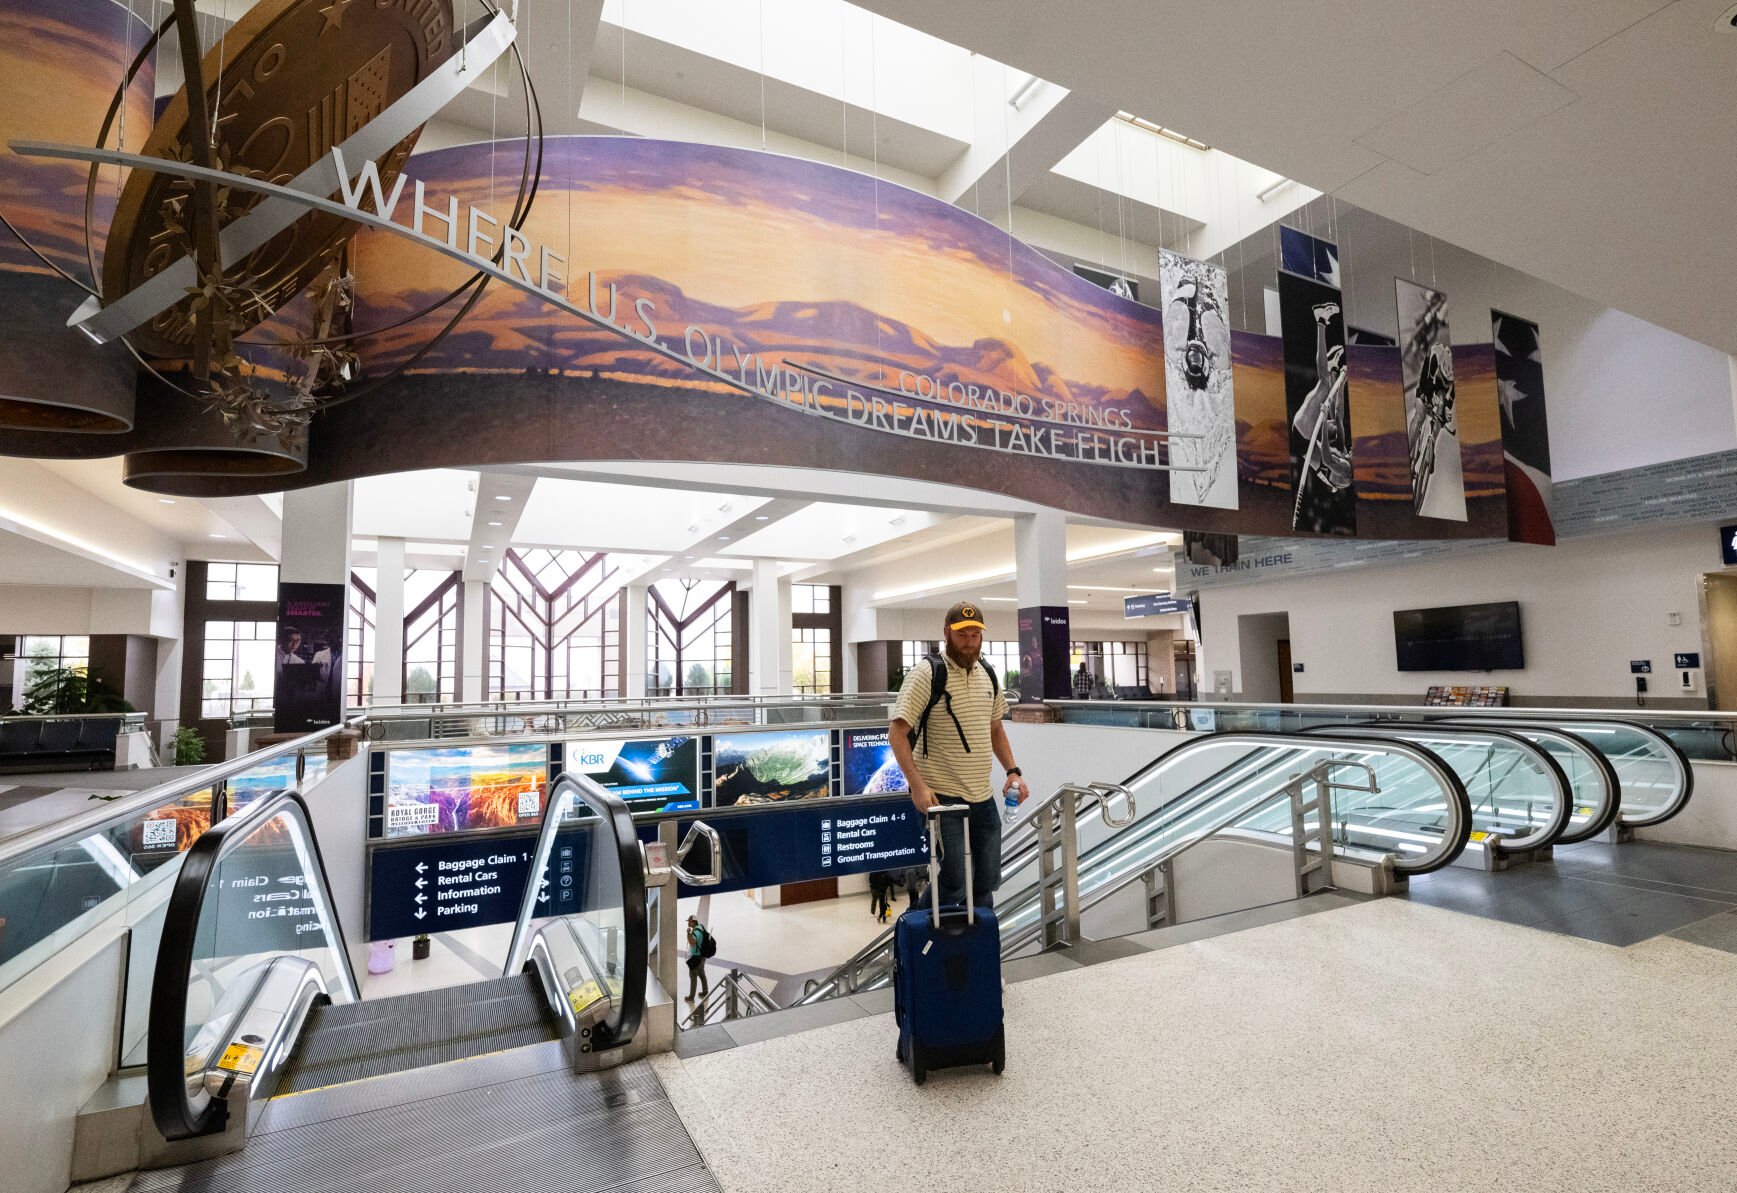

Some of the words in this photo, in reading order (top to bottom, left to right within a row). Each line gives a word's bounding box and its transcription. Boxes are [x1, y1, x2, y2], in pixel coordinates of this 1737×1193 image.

[331, 146, 570, 302] WHERE
[588, 271, 668, 351] U.S.
[684, 325, 834, 417] OLYMPIC
[847, 389, 978, 446] DREAMS
[986, 418, 1067, 459] TAKE
[1077, 431, 1180, 468] FLIGHT
[899, 371, 1034, 418] COLORADO
[1041, 399, 1132, 430] SPRINGS
[1191, 566, 1210, 577] WE
[1254, 553, 1293, 568] HERE
[580, 753, 605, 766] KBR
[622, 788, 643, 796] BEHIND
[390, 815, 413, 823] BRIDGE
[391, 808, 412, 817] ROYAL
[414, 806, 437, 815] GORGE
[836, 817, 868, 828] Baggage
[868, 814, 889, 824] Claim
[891, 813, 896, 822] 4
[901, 812, 906, 821] 6
[837, 829, 860, 840] Rental
[861, 828, 877, 837] Cars
[837, 840, 875, 852] Restrooms
[438, 858, 486, 872] Baggage
[487, 854, 517, 866] Claim
[522, 852, 528, 861] 1
[837, 852, 865, 864] Ground
[865, 847, 916, 860] Transportation
[438, 872, 473, 886] Rental
[474, 871, 498, 882] Cars
[437, 884, 502, 902] Information
[437, 902, 479, 917] Parking
